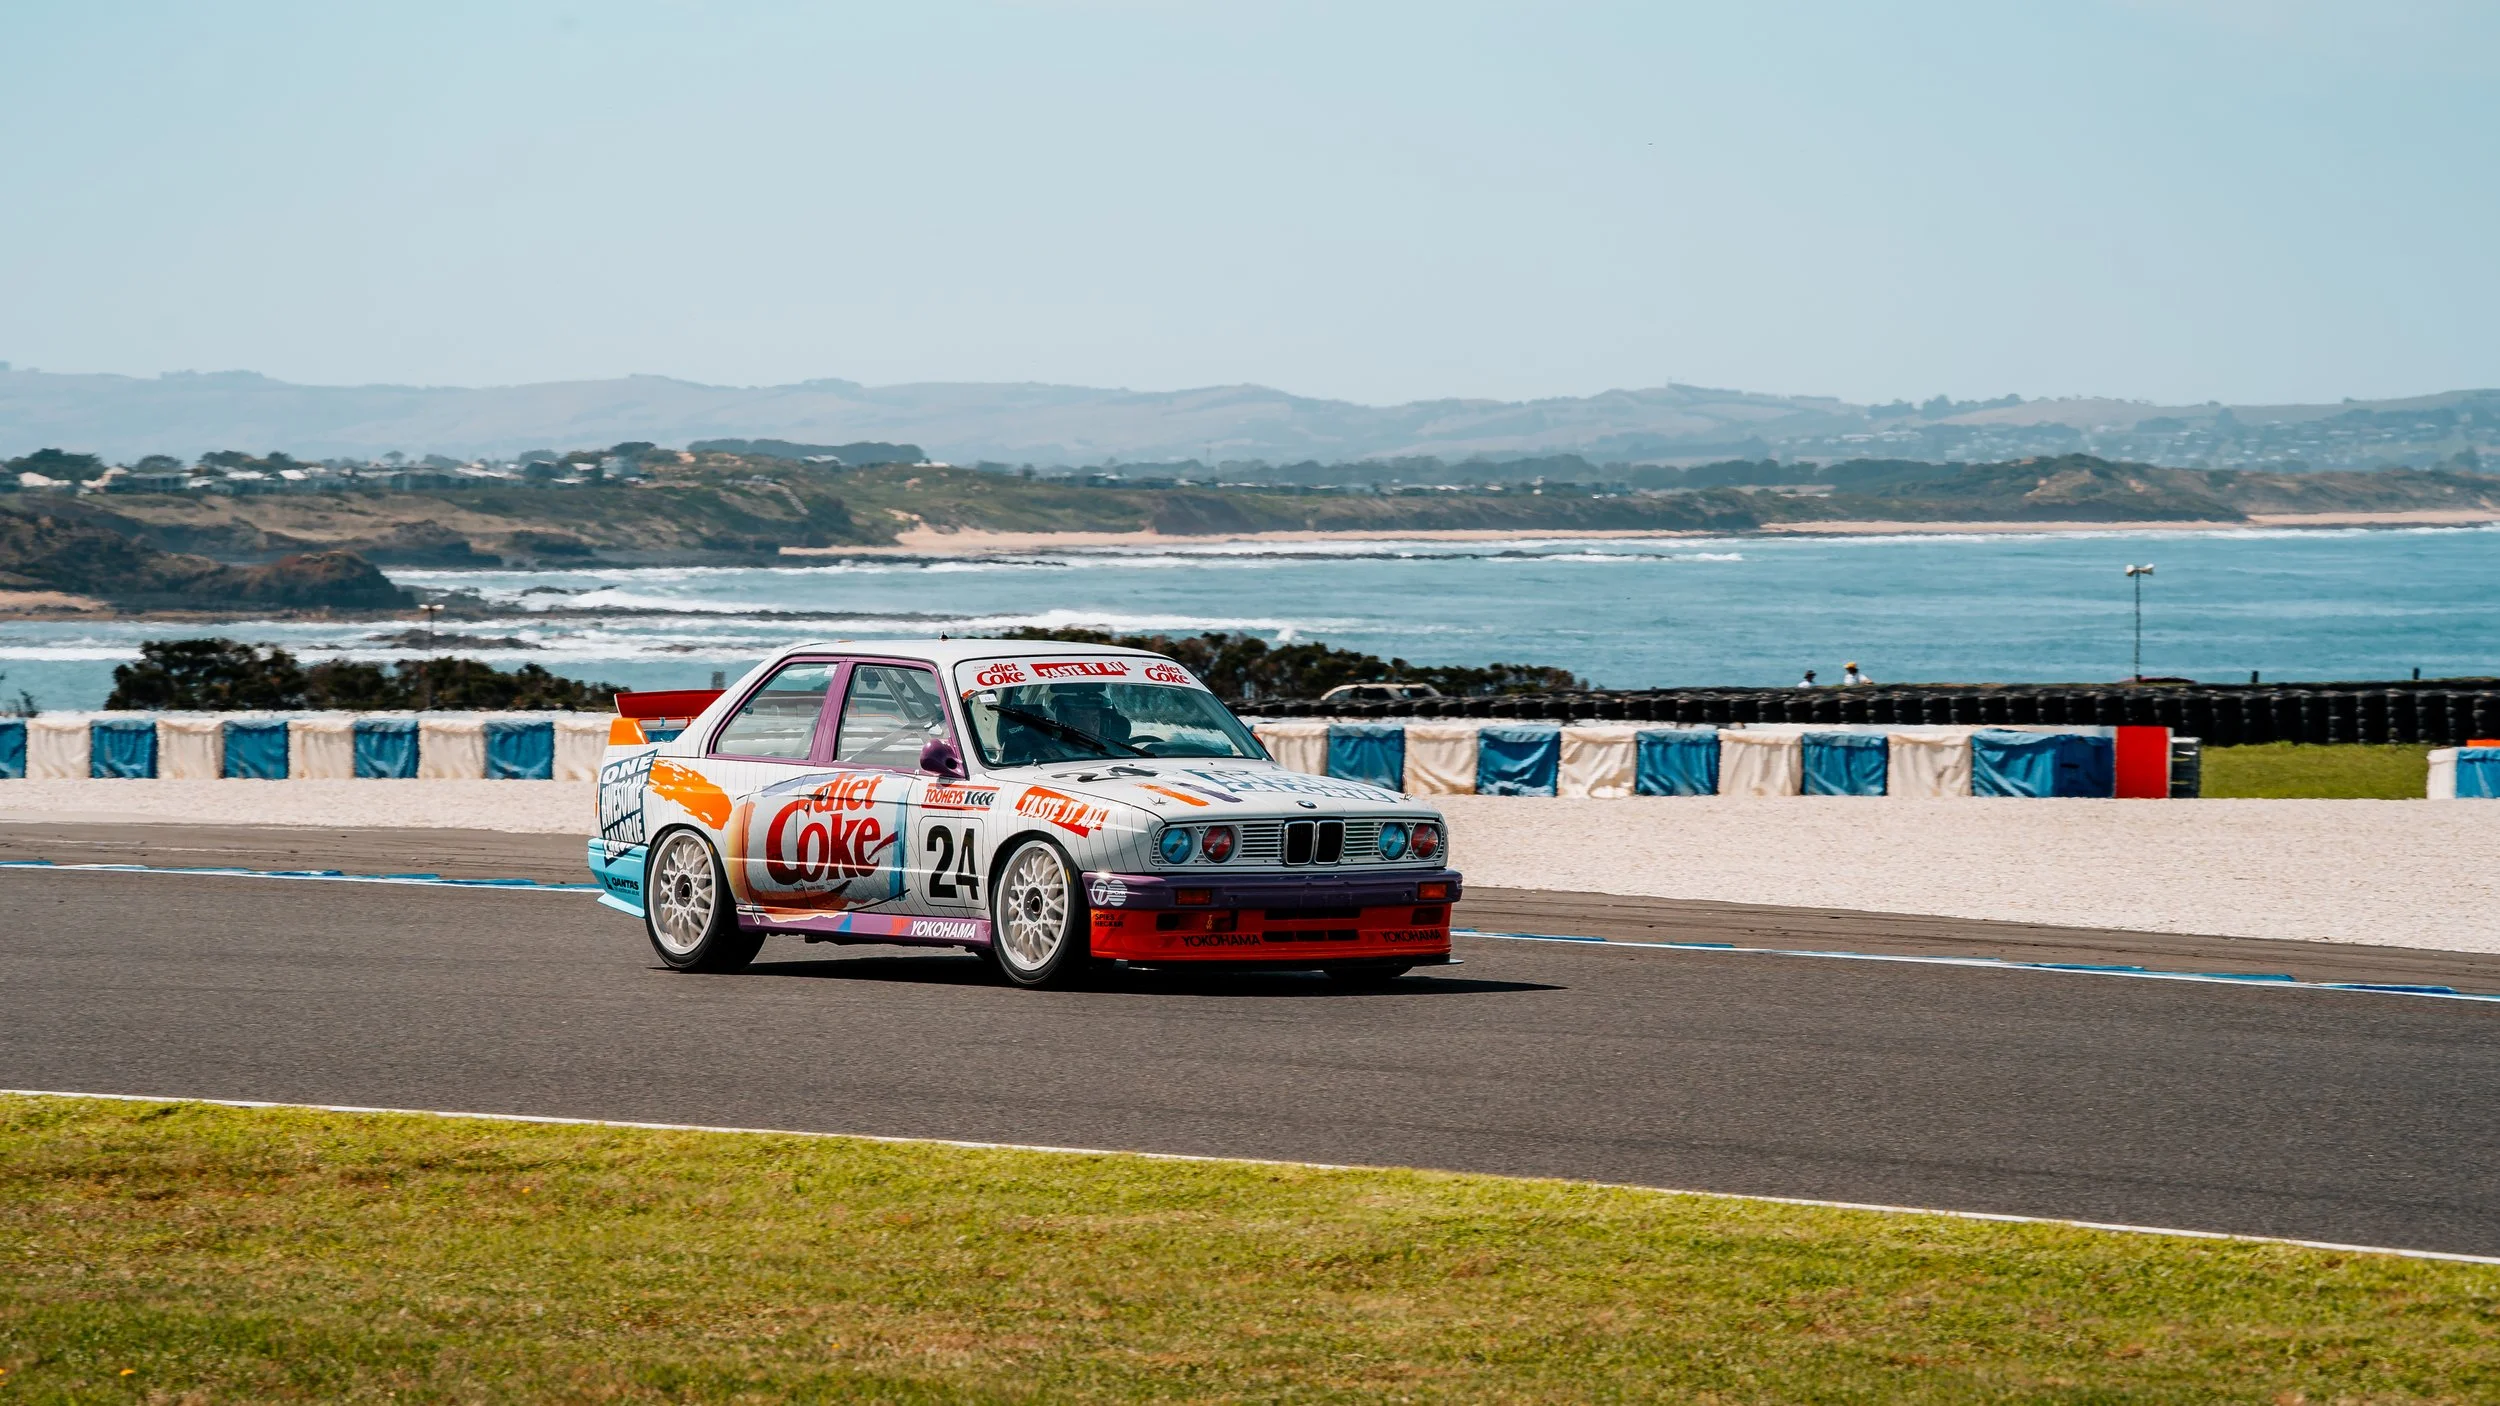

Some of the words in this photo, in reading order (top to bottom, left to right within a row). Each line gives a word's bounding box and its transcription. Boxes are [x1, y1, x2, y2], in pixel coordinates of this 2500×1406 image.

[990, 663, 1018, 673] diet
[1039, 664, 1087, 679] TASTE
[1084, 662, 1103, 674] IT
[1144, 667, 1191, 685] Coke
[1156, 663, 1183, 675] diet
[976, 671, 1027, 687] Coke
[602, 754, 655, 784] ONE
[813, 772, 883, 814] diet
[924, 788, 965, 805] TOOHEYS
[964, 791, 997, 806] 1000
[1019, 794, 1066, 820] TASTE
[1058, 800, 1083, 825] IT
[766, 799, 898, 886] Coke
[926, 824, 980, 900] 24
[611, 876, 640, 891] QANTAS
[1095, 913, 1115, 921] SPIES
[1095, 920, 1124, 928] HECKER
[911, 921, 977, 938] YOKOHAMA
[1379, 928, 1443, 944] YOKOHAMA
[1181, 933, 1262, 948] YOKOHAMA
